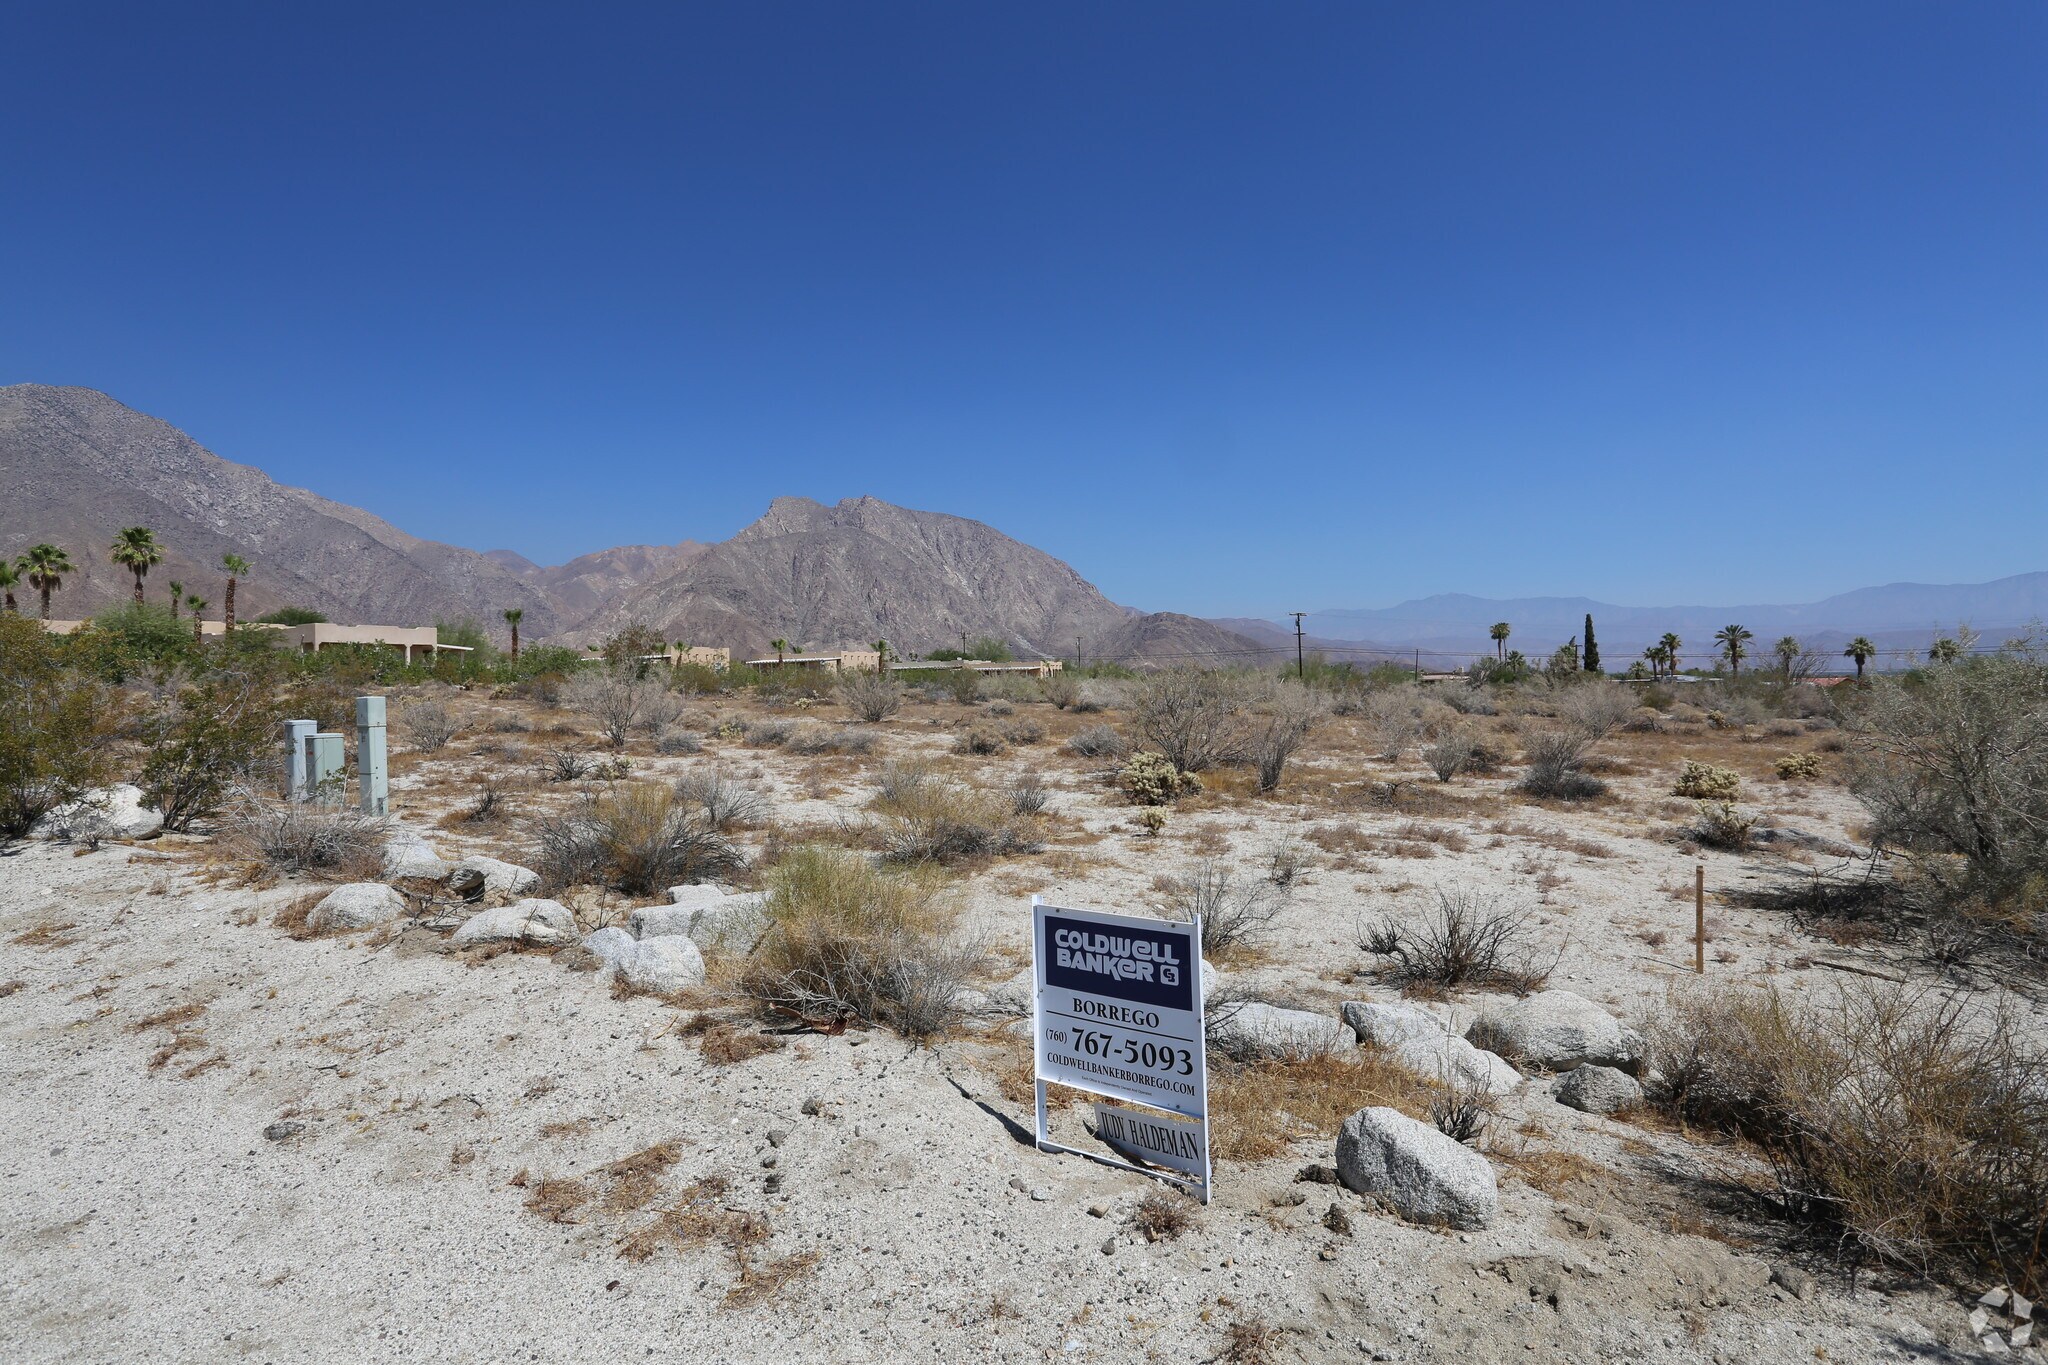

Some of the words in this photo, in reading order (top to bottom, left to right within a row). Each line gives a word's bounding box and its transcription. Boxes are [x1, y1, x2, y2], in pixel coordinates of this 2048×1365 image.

[1055, 928, 1180, 965] COLDWELL
[1057, 947, 1154, 983] BANKER
[1073, 997, 1160, 1028] BORREGO
[1045, 1027, 1068, 1045] (760)
[1071, 1026, 1193, 1076] 767-5093
[1047, 1051, 1195, 1096] COLDWELLBANKERBORREGO.COM
[1100, 1111, 1127, 1142] JUDY
[1128, 1119, 1200, 1161] HALDEMAN
